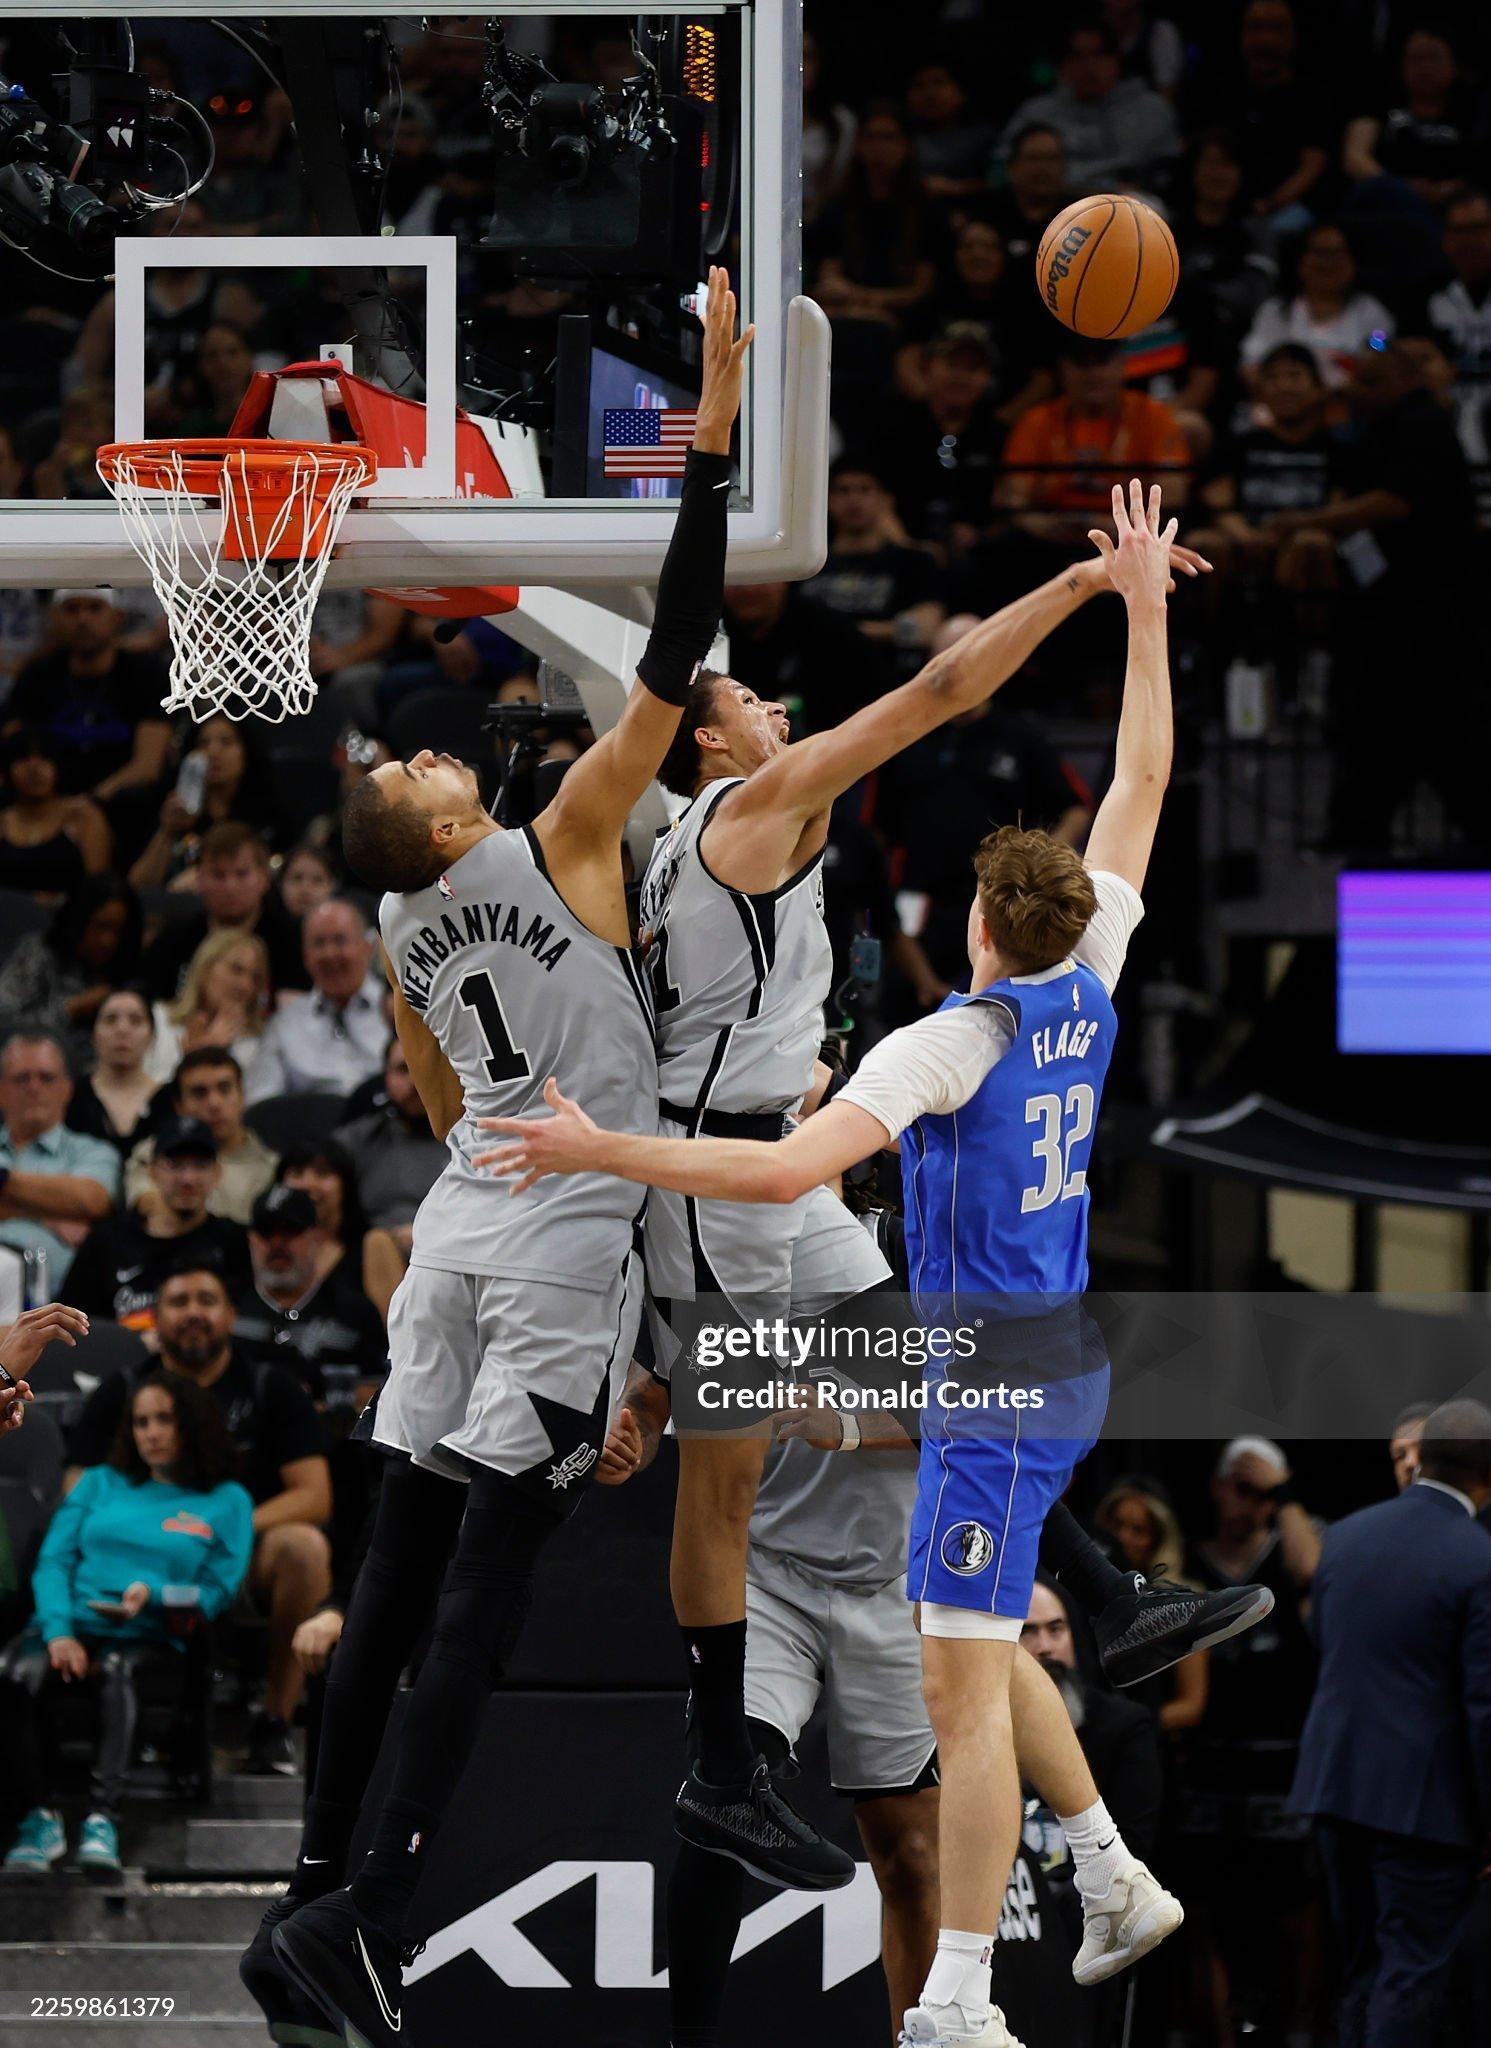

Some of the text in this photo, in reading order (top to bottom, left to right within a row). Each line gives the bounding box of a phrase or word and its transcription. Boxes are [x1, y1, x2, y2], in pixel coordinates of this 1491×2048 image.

[1046, 225, 1092, 312] Wilson
[402, 903, 572, 1011] WEMBANYAMA
[455, 968, 534, 1088] 1
[1031, 1019, 1099, 1070] FLAGG
[1020, 1083, 1095, 1214] 32
